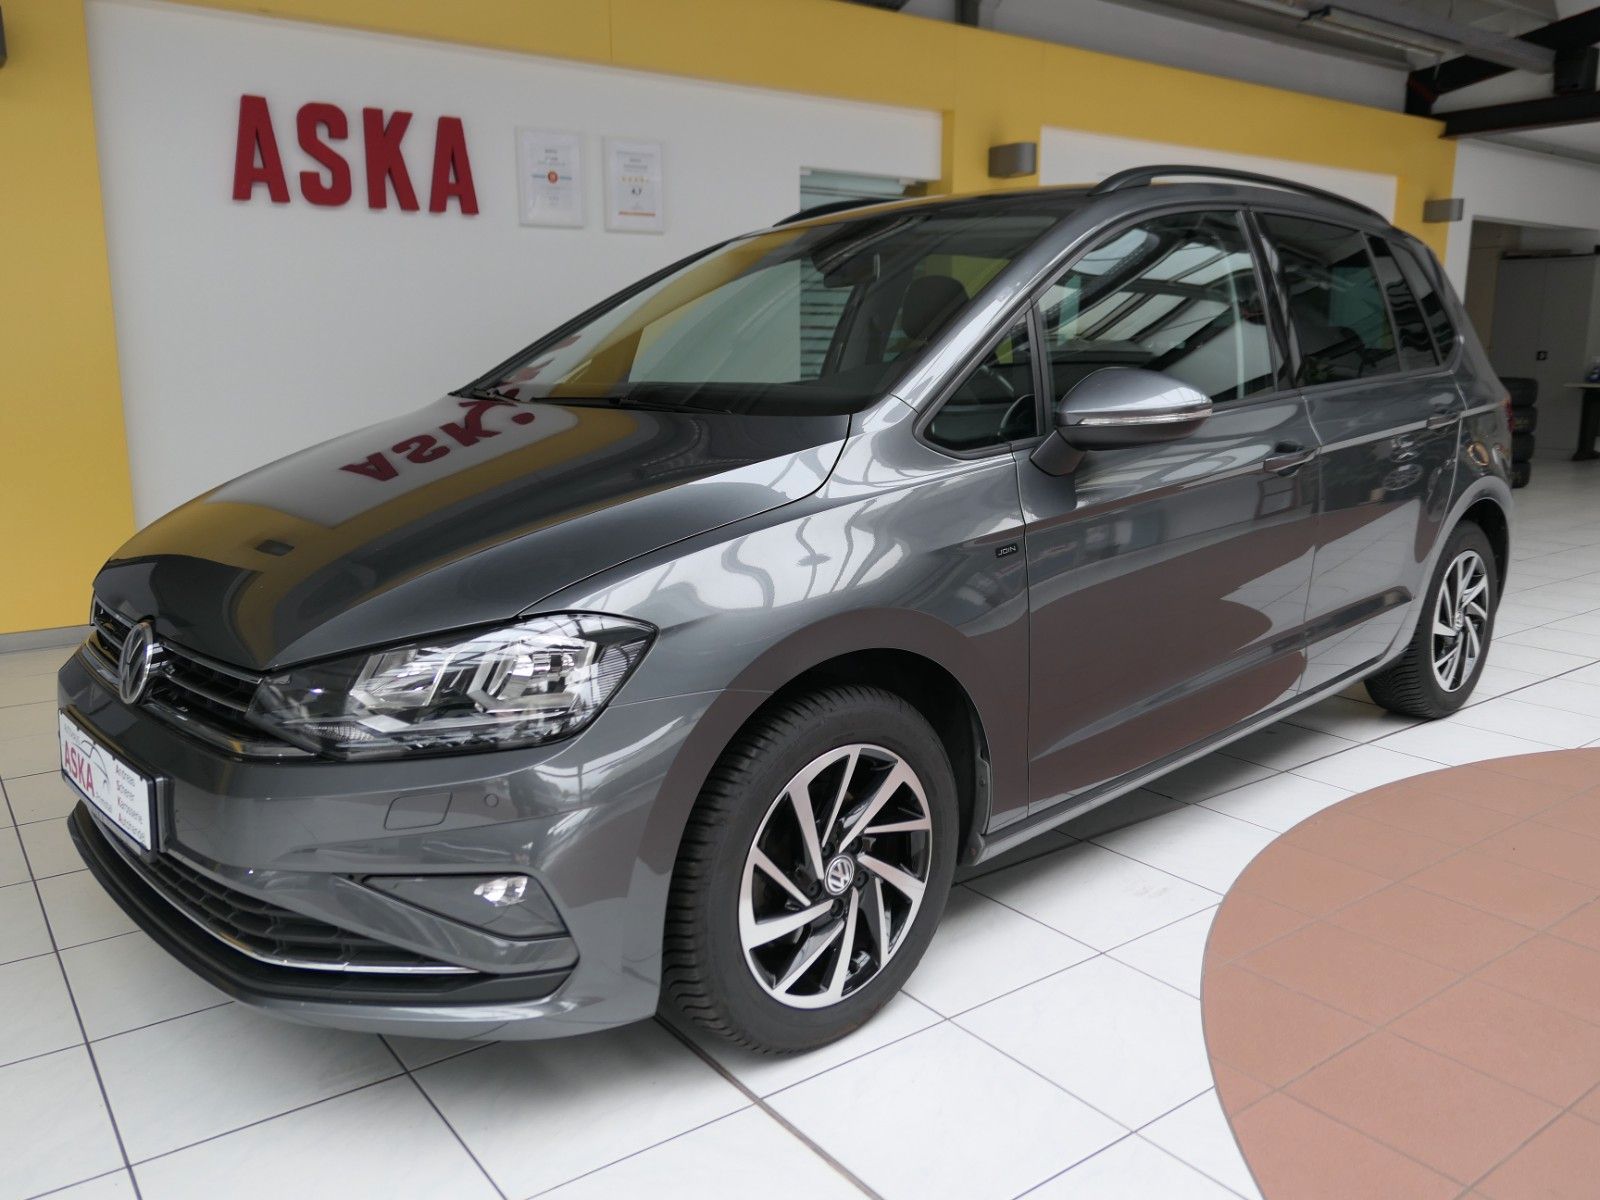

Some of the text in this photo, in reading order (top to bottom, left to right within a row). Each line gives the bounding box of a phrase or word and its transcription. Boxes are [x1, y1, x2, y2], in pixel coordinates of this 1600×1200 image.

[232, 93, 479, 215] ASKA
[998, 545, 1017, 556] JOIN
[64, 740, 95, 797] ASKA
